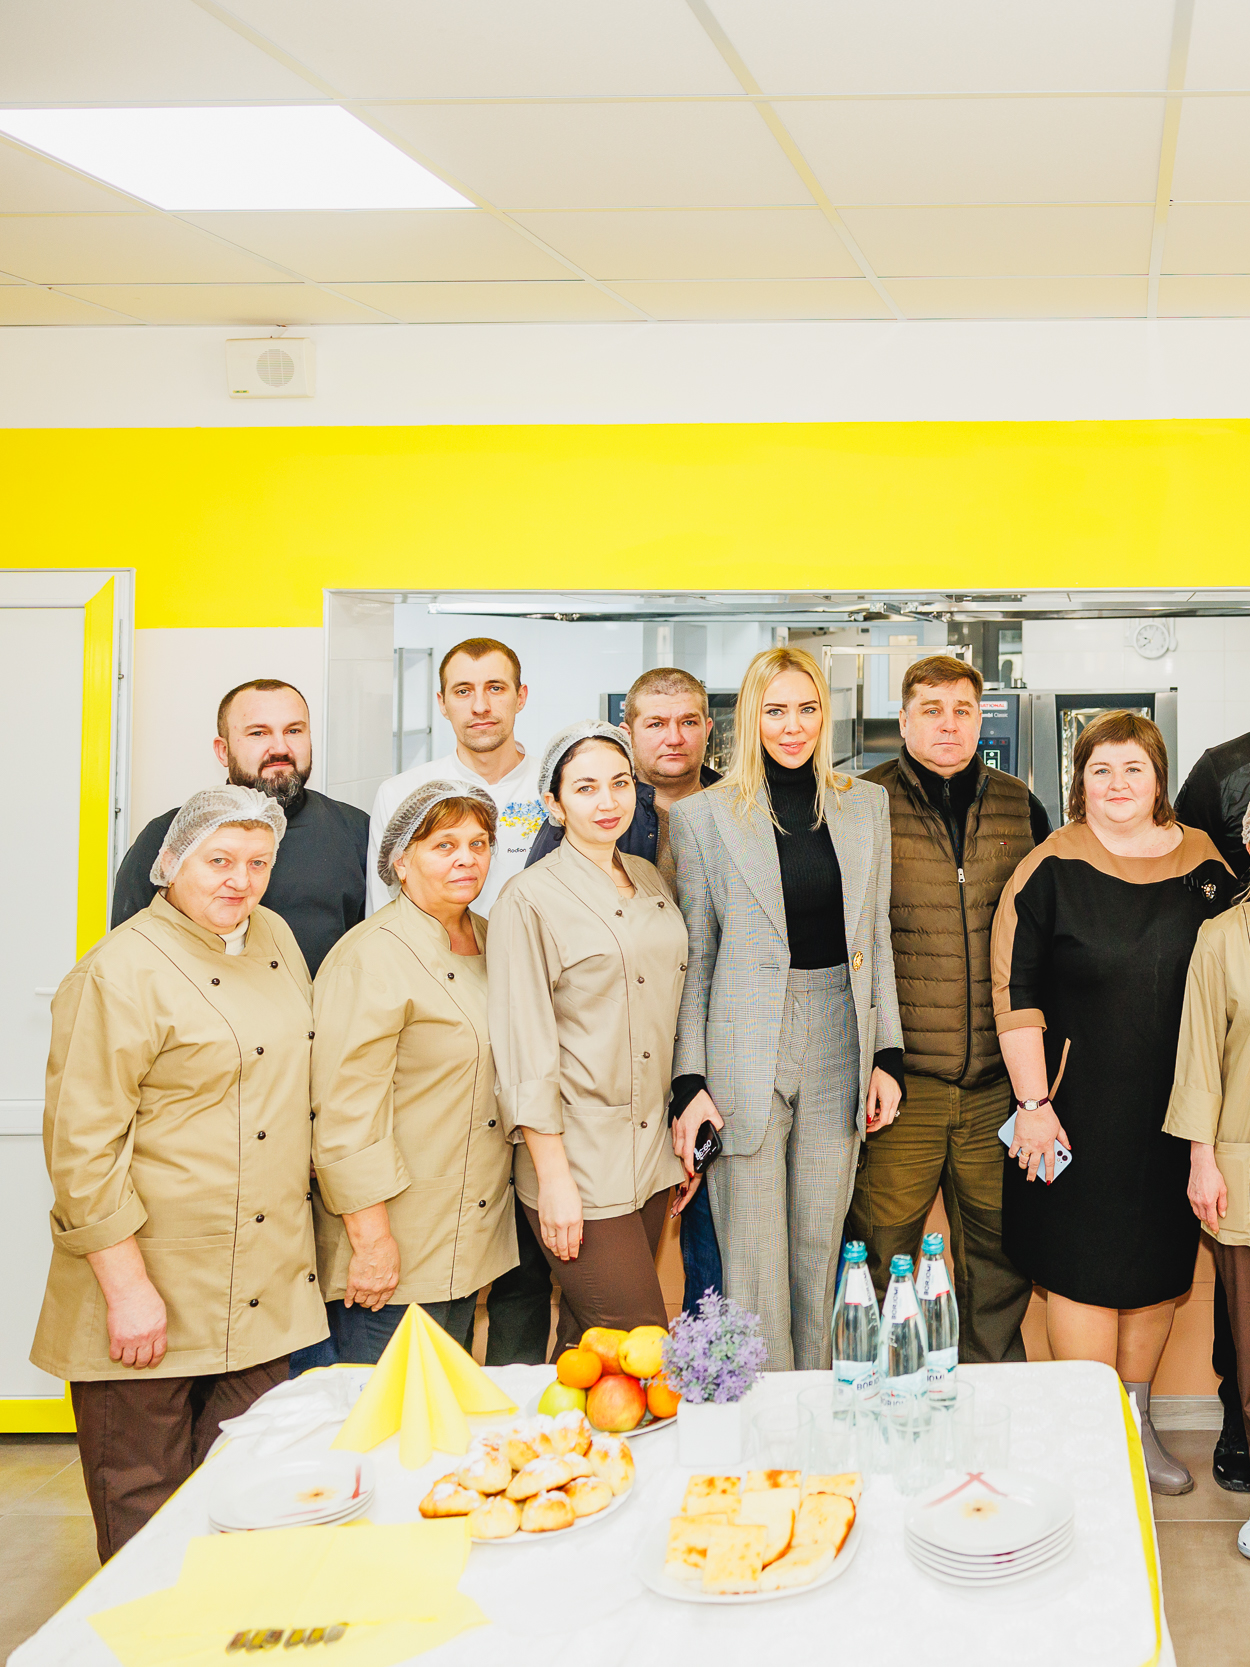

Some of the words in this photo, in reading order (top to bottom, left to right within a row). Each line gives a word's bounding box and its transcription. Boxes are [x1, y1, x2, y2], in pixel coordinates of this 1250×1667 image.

[923, 1263, 932, 1296] BORJOMI
[891, 1286, 899, 1320] BORJOMI
[857, 1377, 880, 1391] BORJO
[926, 1374, 945, 1383] JOMI
